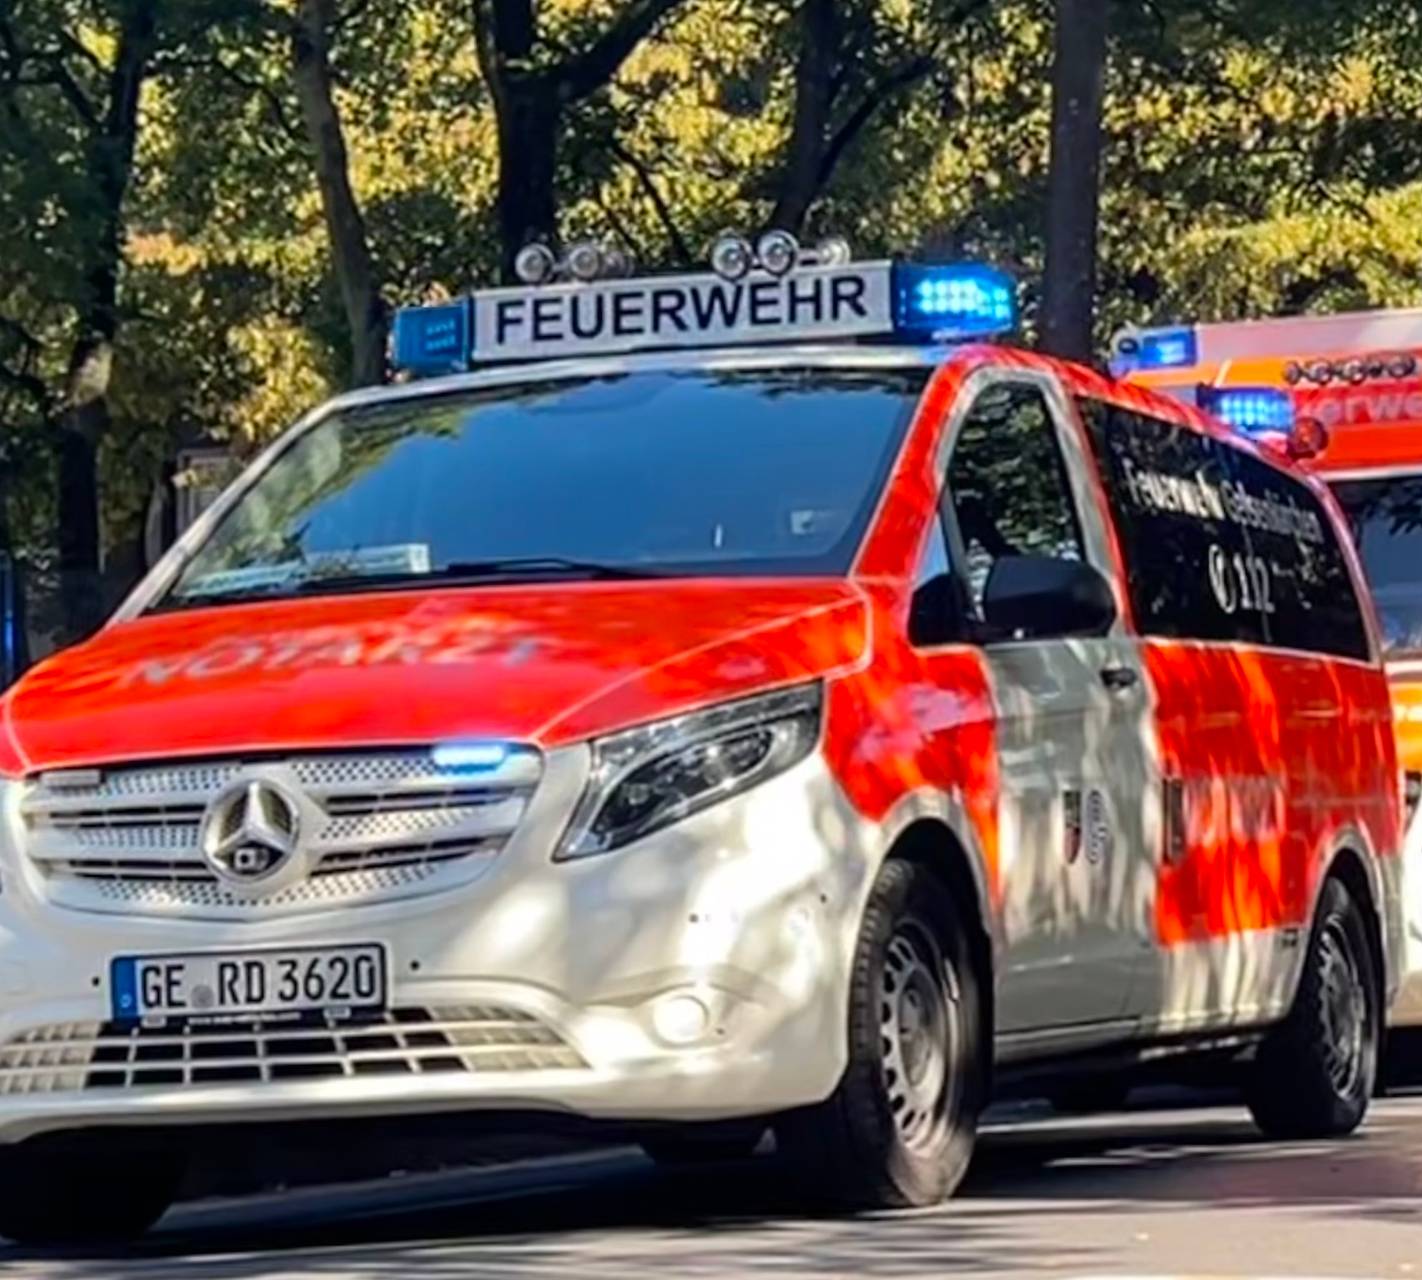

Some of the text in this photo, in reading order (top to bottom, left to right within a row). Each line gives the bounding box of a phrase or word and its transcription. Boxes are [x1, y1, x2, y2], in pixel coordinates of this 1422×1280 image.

[495, 274, 867, 346] FEUERWEHR
[119, 618, 560, 689] NOTARZT
[140, 953, 376, 1009] GE RD 3620
